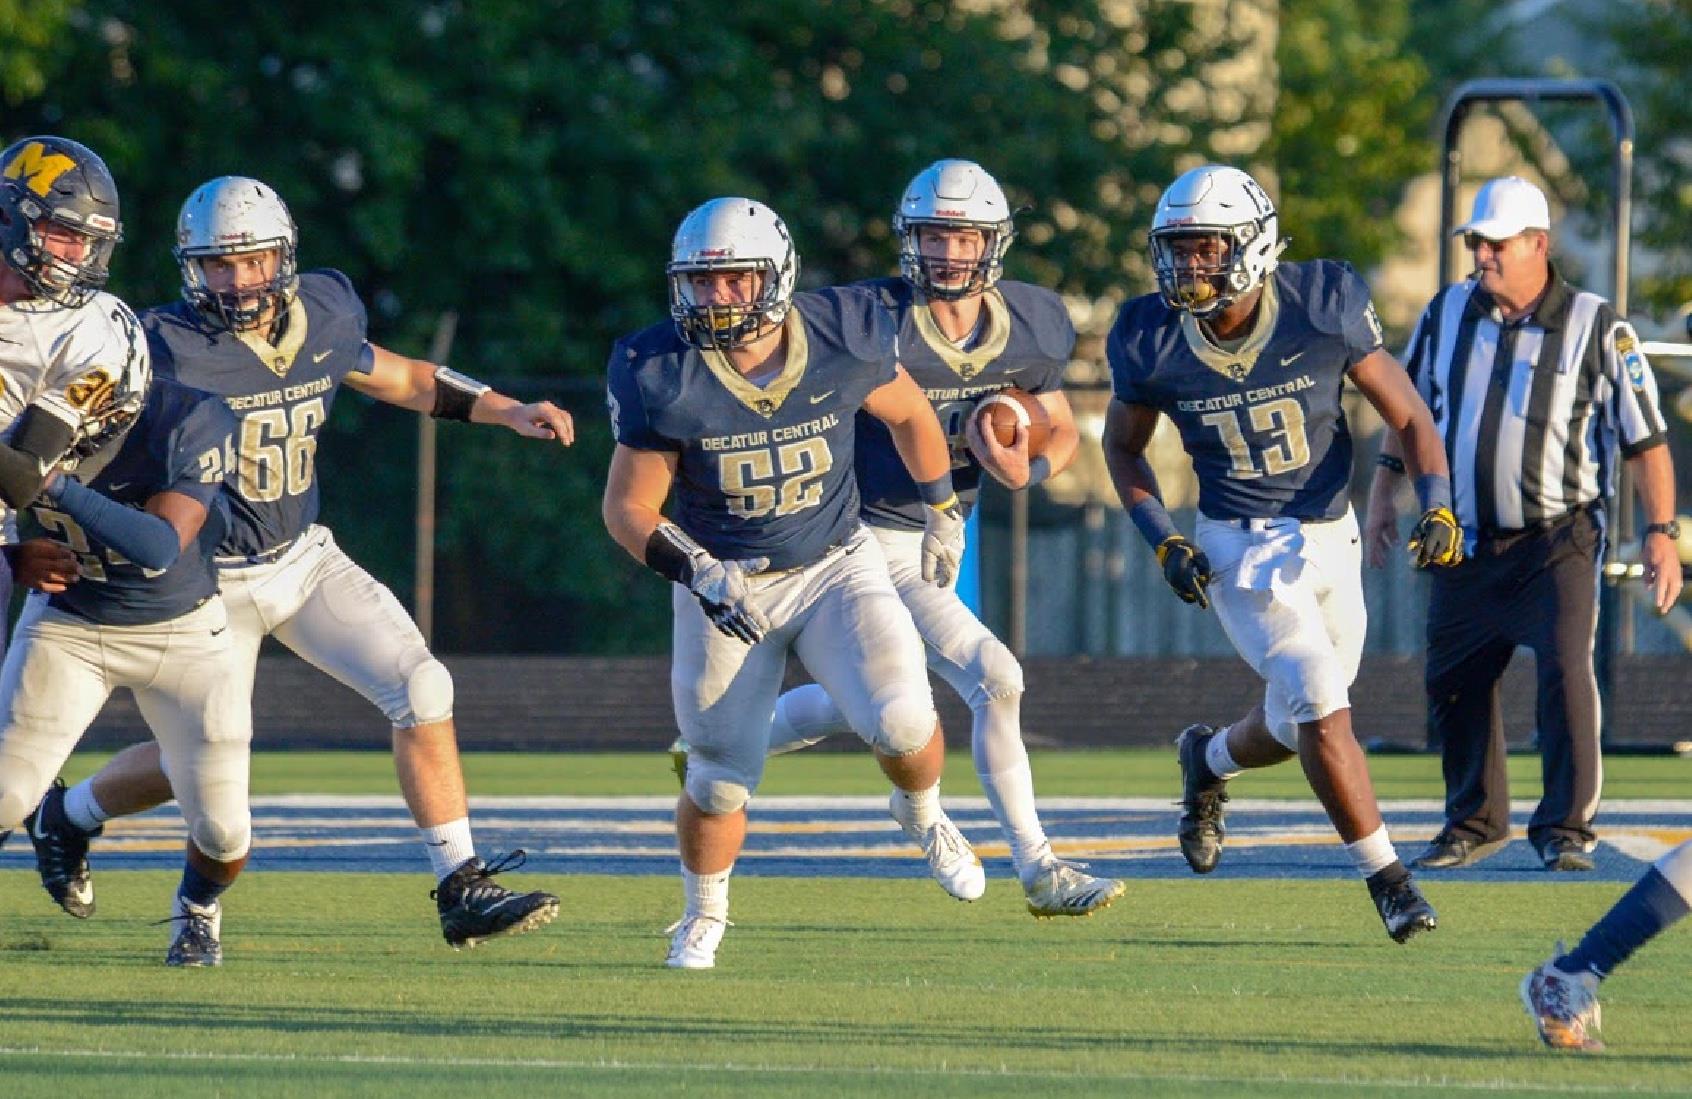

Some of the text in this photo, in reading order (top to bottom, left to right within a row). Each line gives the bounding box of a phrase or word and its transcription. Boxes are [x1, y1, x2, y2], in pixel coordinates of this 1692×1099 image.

[3, 142, 77, 197] M
[1177, 375, 1316, 411] DECATUR CENTRAL
[238, 397, 325, 502] 66
[701, 413, 839, 450] DECATUR CENTRAL
[1201, 398, 1310, 480] 13
[719, 436, 833, 520] 52
